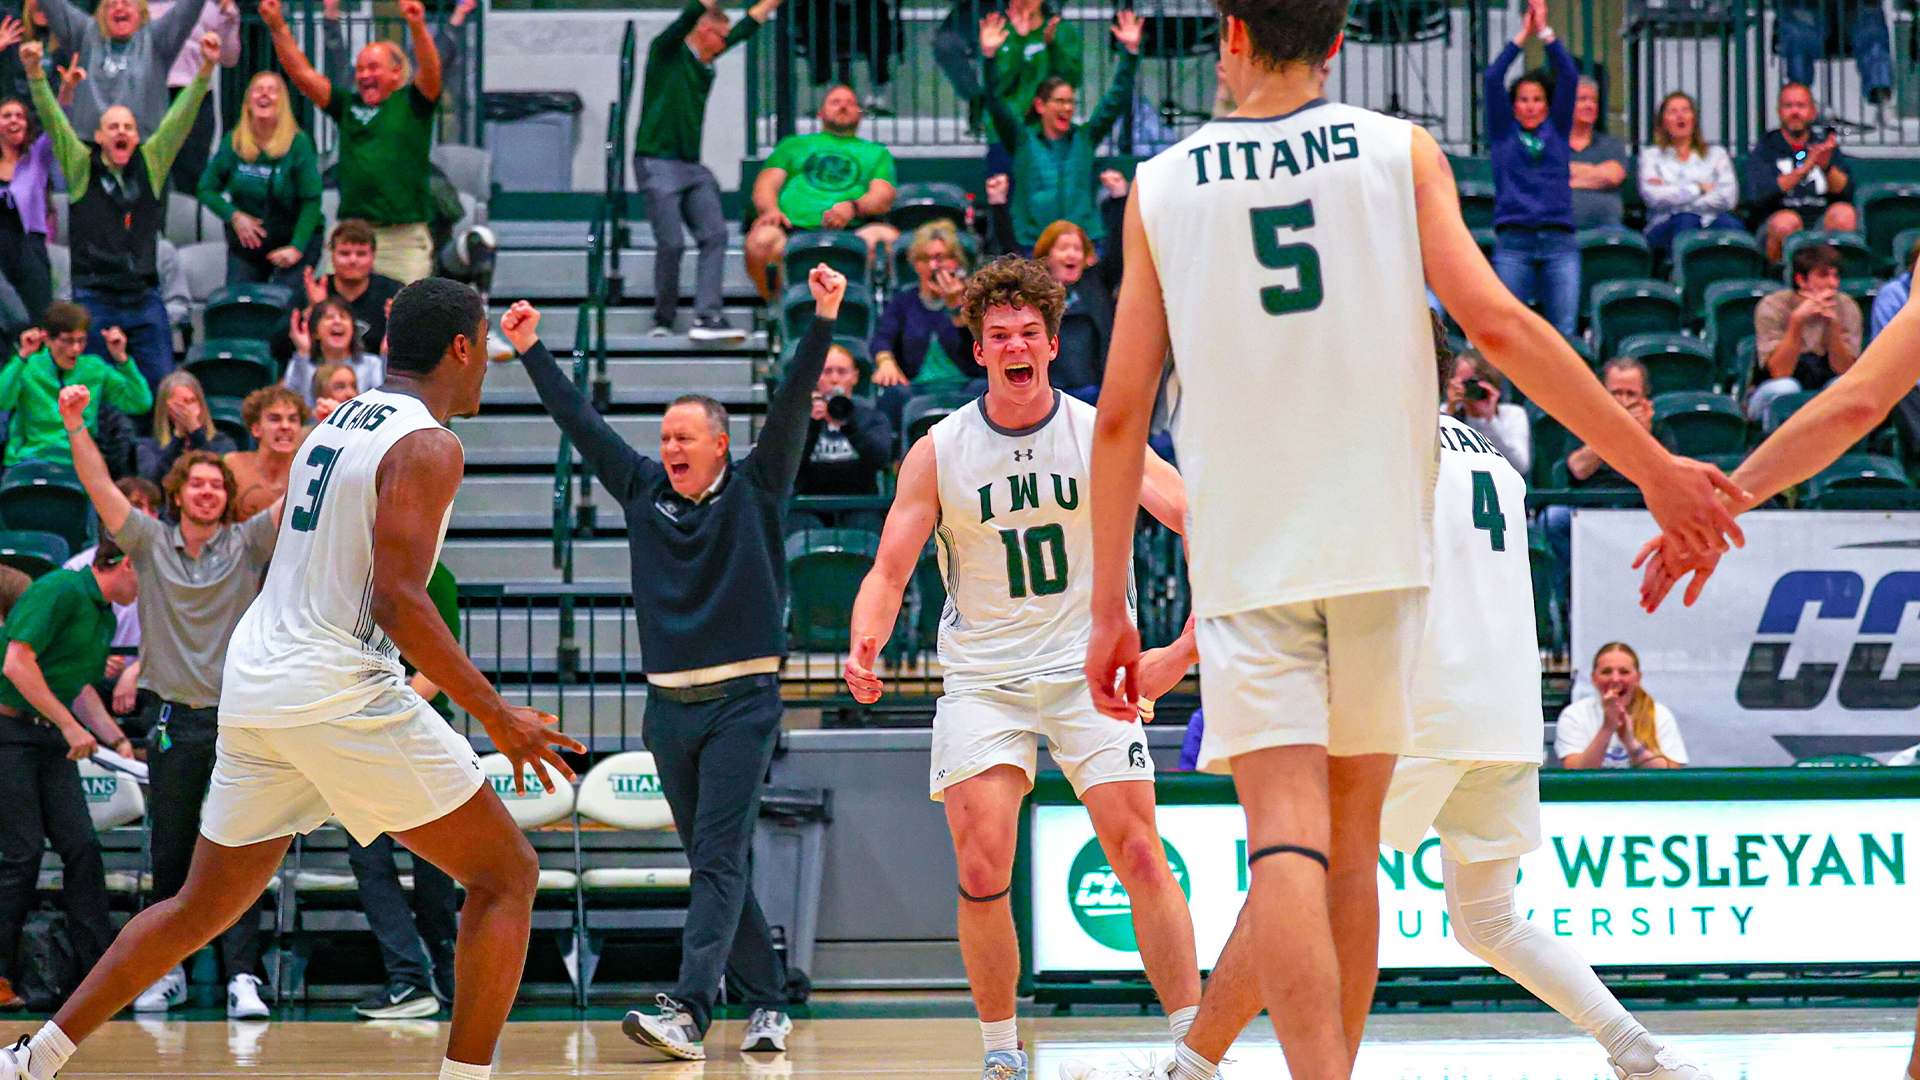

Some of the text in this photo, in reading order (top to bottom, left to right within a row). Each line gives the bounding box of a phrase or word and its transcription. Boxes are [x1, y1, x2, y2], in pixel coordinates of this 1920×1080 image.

[1188, 123, 1360, 186] TITANS
[1249, 198, 1324, 316] 5
[322, 399, 398, 432] ITANS
[977, 472, 1079, 524] IWU
[1471, 470, 1507, 552] 4
[998, 523, 1068, 598] 10
[81, 778, 116, 795] ANS
[487, 775, 544, 793] ITANS
[610, 775, 662, 792] TITAN
[1551, 833, 1906, 889] WESLEYAN
[1398, 905, 1754, 938] UERSITY
